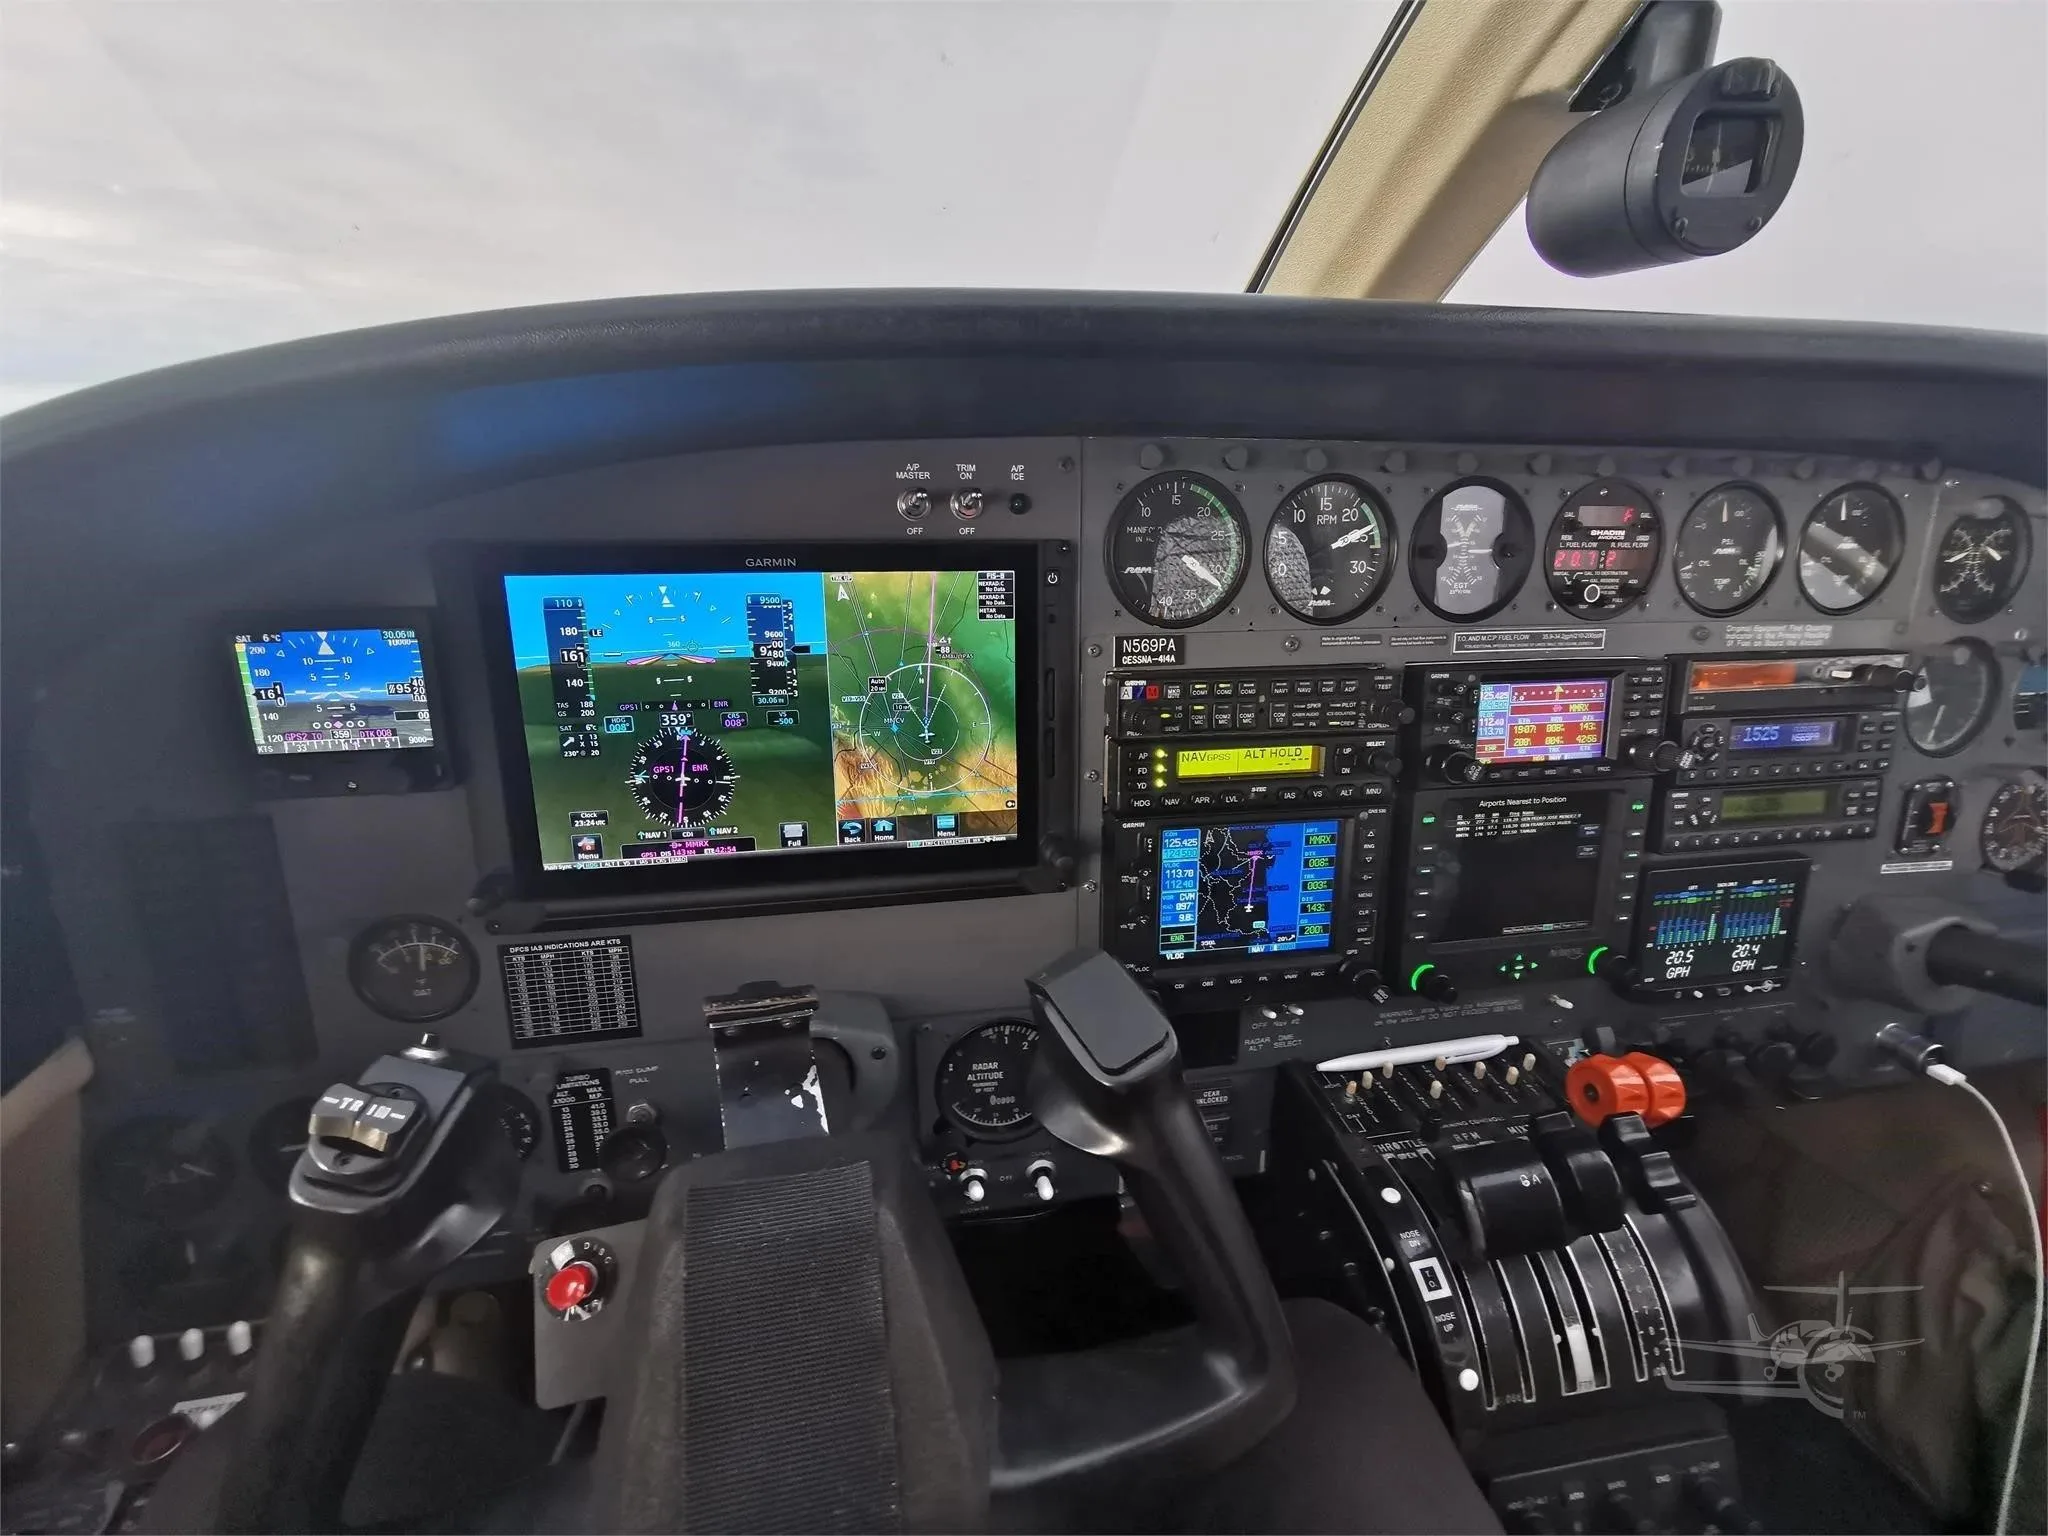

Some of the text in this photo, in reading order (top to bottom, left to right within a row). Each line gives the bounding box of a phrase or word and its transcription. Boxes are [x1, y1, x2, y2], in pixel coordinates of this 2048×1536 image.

[1011, 465, 1024, 473] A/P
[1171, 495, 1181, 505] 15
[1320, 498, 1332, 510] 15
[1141, 507, 1151, 517] 10
[1197, 507, 1210, 516] 20
[1294, 510, 1305, 522] 10
[1342, 509, 1358, 521] 20
[1317, 515, 1337, 525] RPM
[1211, 531, 1224, 540] 25
[1278, 532, 1287, 544] 5
[745, 558, 796, 567] GARMIN
[1350, 561, 1366, 573] 30
[1210, 565, 1222, 574] 30
[1279, 564, 1287, 575] 0
[1183, 590, 1197, 599] 35
[555, 600, 573, 608] 110
[760, 596, 780, 605] 9500
[1159, 596, 1172, 605] 40
[560, 627, 578, 636] 180
[765, 630, 783, 638] 9600
[1123, 639, 1176, 652] N569PA
[1122, 655, 1176, 664] CESSNA-414A
[566, 679, 584, 687] 140
[1481, 692, 1509, 700] 125.425
[714, 700, 728, 708] ENR
[1569, 704, 1589, 712] MMRX
[661, 714, 691, 726] 359°
[377, 729, 392, 737] 008
[1744, 727, 1779, 742] 1525
[1244, 748, 1302, 759] ALT HOLD
[692, 764, 708, 772] ENR
[1479, 800, 1505, 808] Airports
[1507, 798, 1532, 806] Nearest
[1542, 796, 1566, 804] Position
[1164, 839, 1197, 847] 125.425
[1309, 835, 1331, 844] MMRX
[578, 852, 598, 860] Menu
[1166, 870, 1193, 878] 113.70
[1166, 880, 1193, 888] 112.40
[545, 941, 590, 950] INDICATIONS
[591, 939, 605, 947] ARE
[1732, 944, 1760, 959] 20.4
[1666, 950, 1694, 965] 20.5
[1732, 960, 1756, 972] GPH
[1667, 967, 1690, 979] GPH
[972, 1062, 999, 1071] RADAR
[967, 1071, 1004, 1080] ALTITUDE
[557, 1080, 600, 1089] LIMITATIONS
[1374, 1139, 1427, 1152] THROTTLE
[1400, 1229, 1420, 1241] NOSE
[1409, 1238, 1421, 1248] DN
[1435, 1312, 1456, 1323] NOSE
[1442, 1322, 1454, 1333] UP
